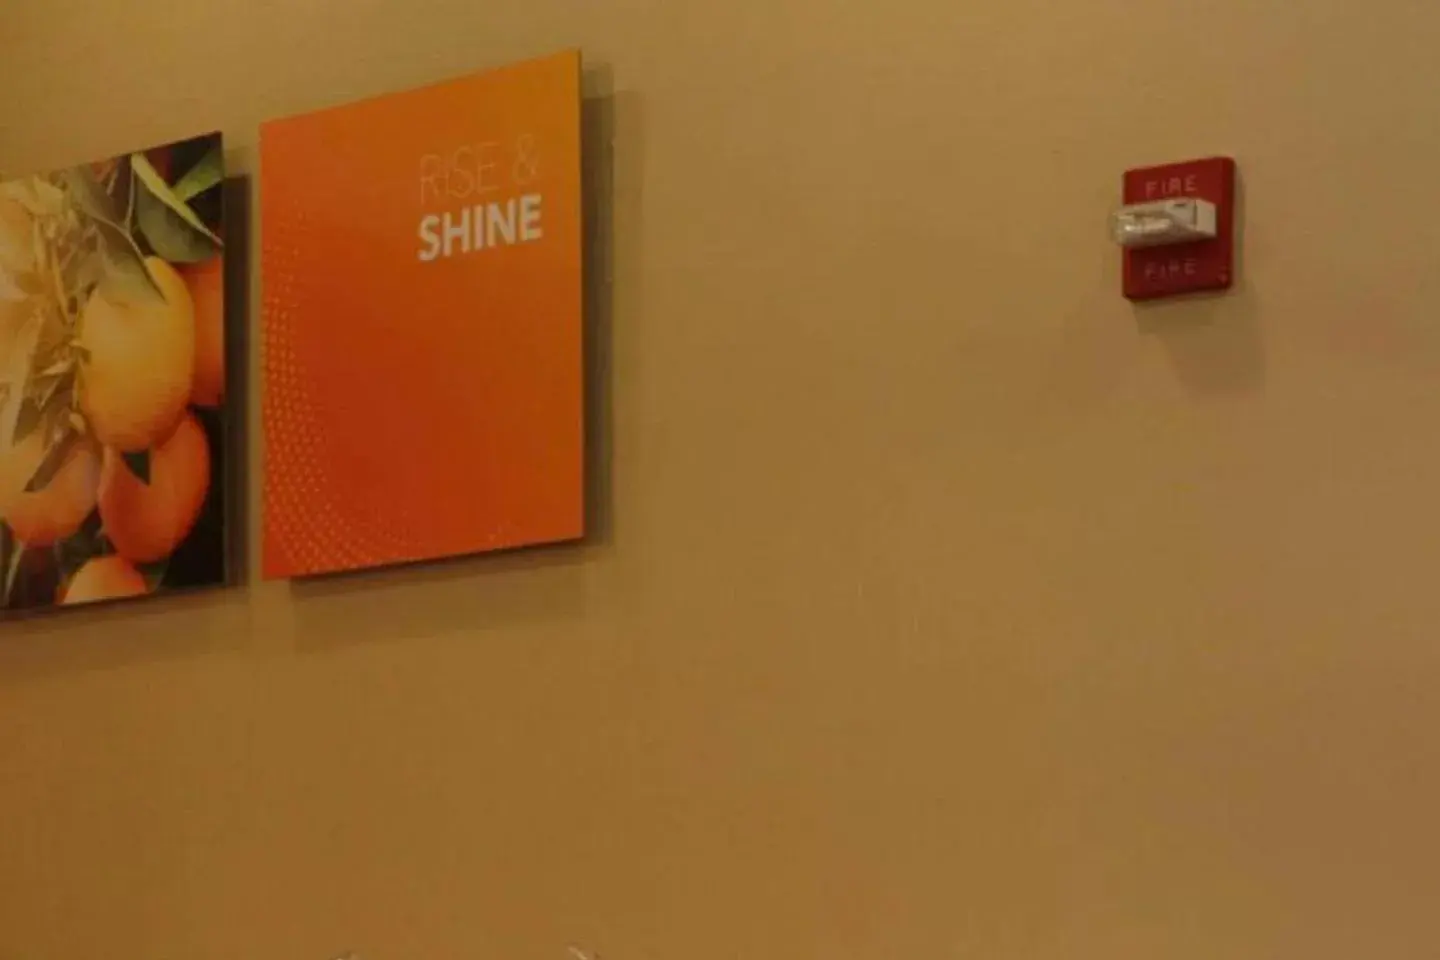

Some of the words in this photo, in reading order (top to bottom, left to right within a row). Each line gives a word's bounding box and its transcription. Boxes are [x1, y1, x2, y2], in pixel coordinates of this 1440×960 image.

[420, 142, 500, 205] RISE
[512, 133, 539, 185] &
[1144, 174, 1198, 199] FIRE
[418, 193, 543, 261] SHINE
